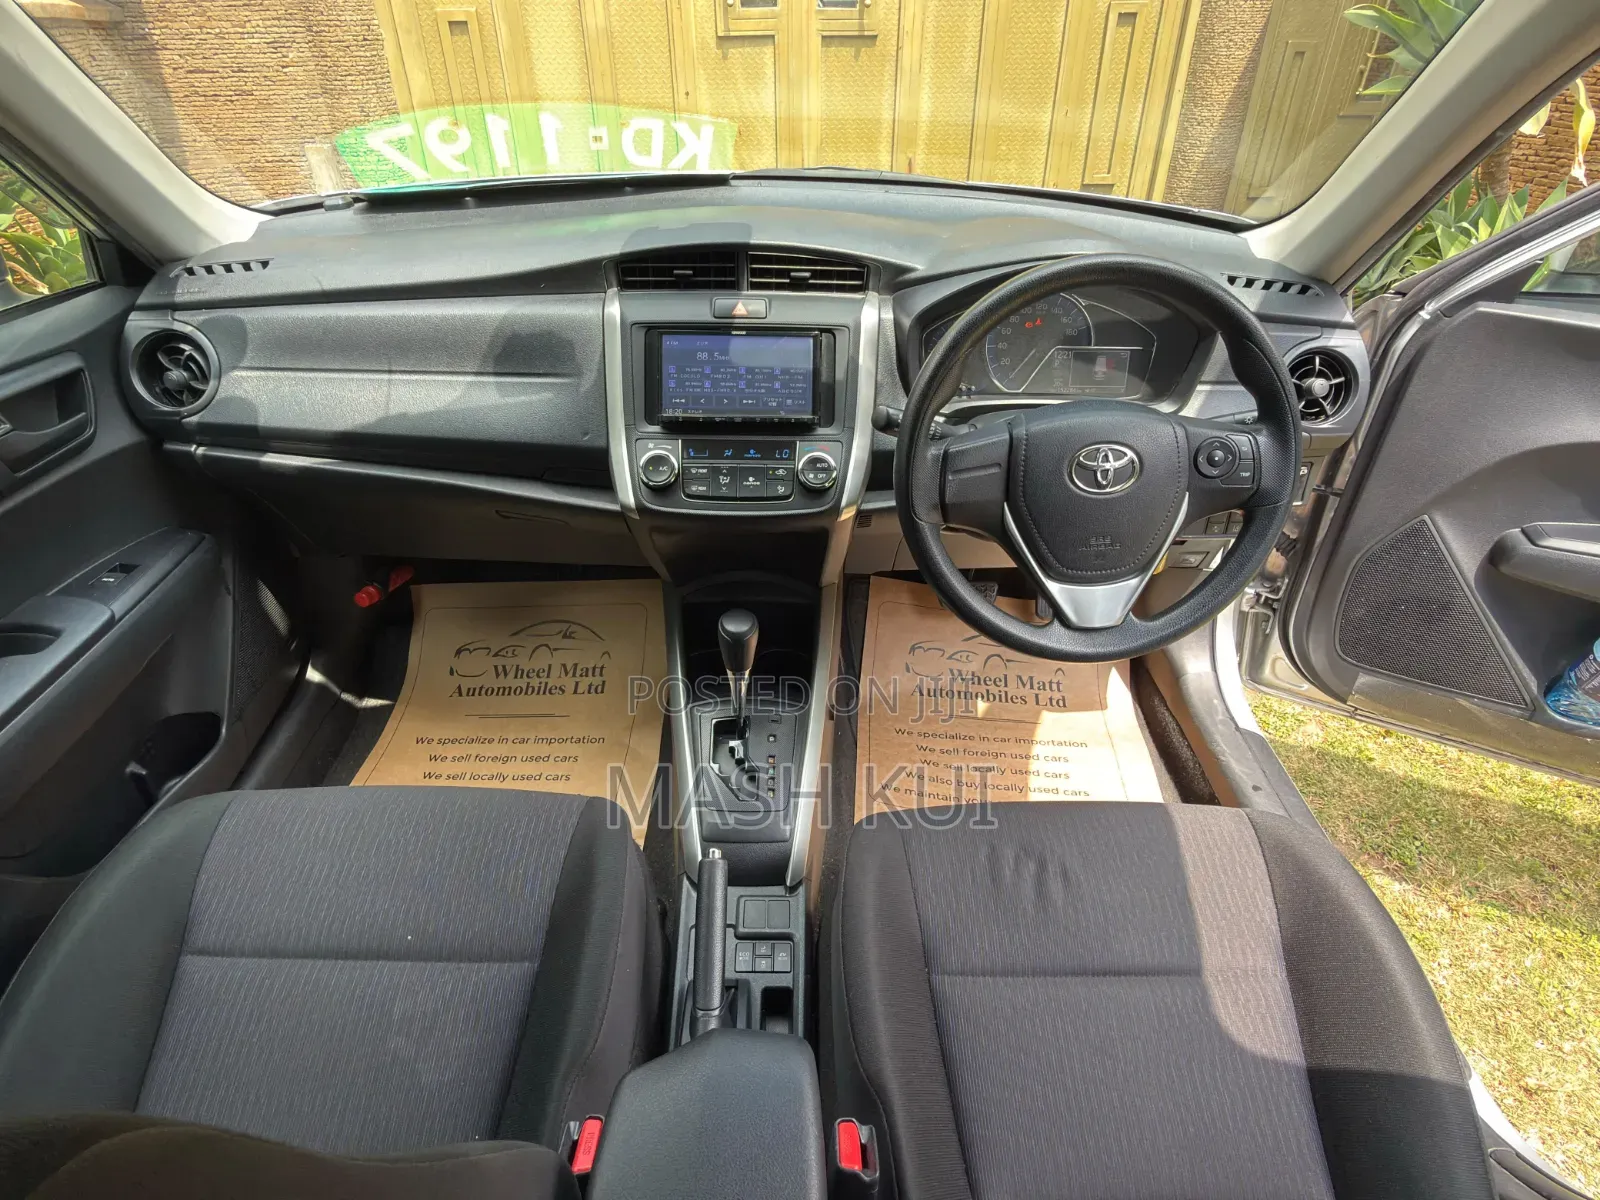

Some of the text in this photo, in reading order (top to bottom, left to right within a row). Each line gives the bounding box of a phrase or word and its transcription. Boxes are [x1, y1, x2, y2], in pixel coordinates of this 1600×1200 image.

[1009, 315, 1020, 323] 80
[1000, 357, 1010, 365] 20
[492, 662, 606, 680] Wheel Matt
[449, 680, 606, 698] Automobiles Ltd
[948, 668, 1063, 693] Wheel Matt
[911, 685, 1068, 708] Automobiles Ltd
[415, 734, 606, 746] We specialize in car importation
[894, 728, 1089, 749] We specialize in car importation
[428, 753, 579, 764] We sell foreign used cars
[916, 744, 1069, 763] We sell foreign used cars
[422, 771, 571, 783] We sell locally used cars
[919, 758, 1070, 780] We sell locally used cars
[905, 770, 1090, 797] We also buy locally used cars
[880, 782, 902, 794] We
[904, 786, 960, 804] maintain
